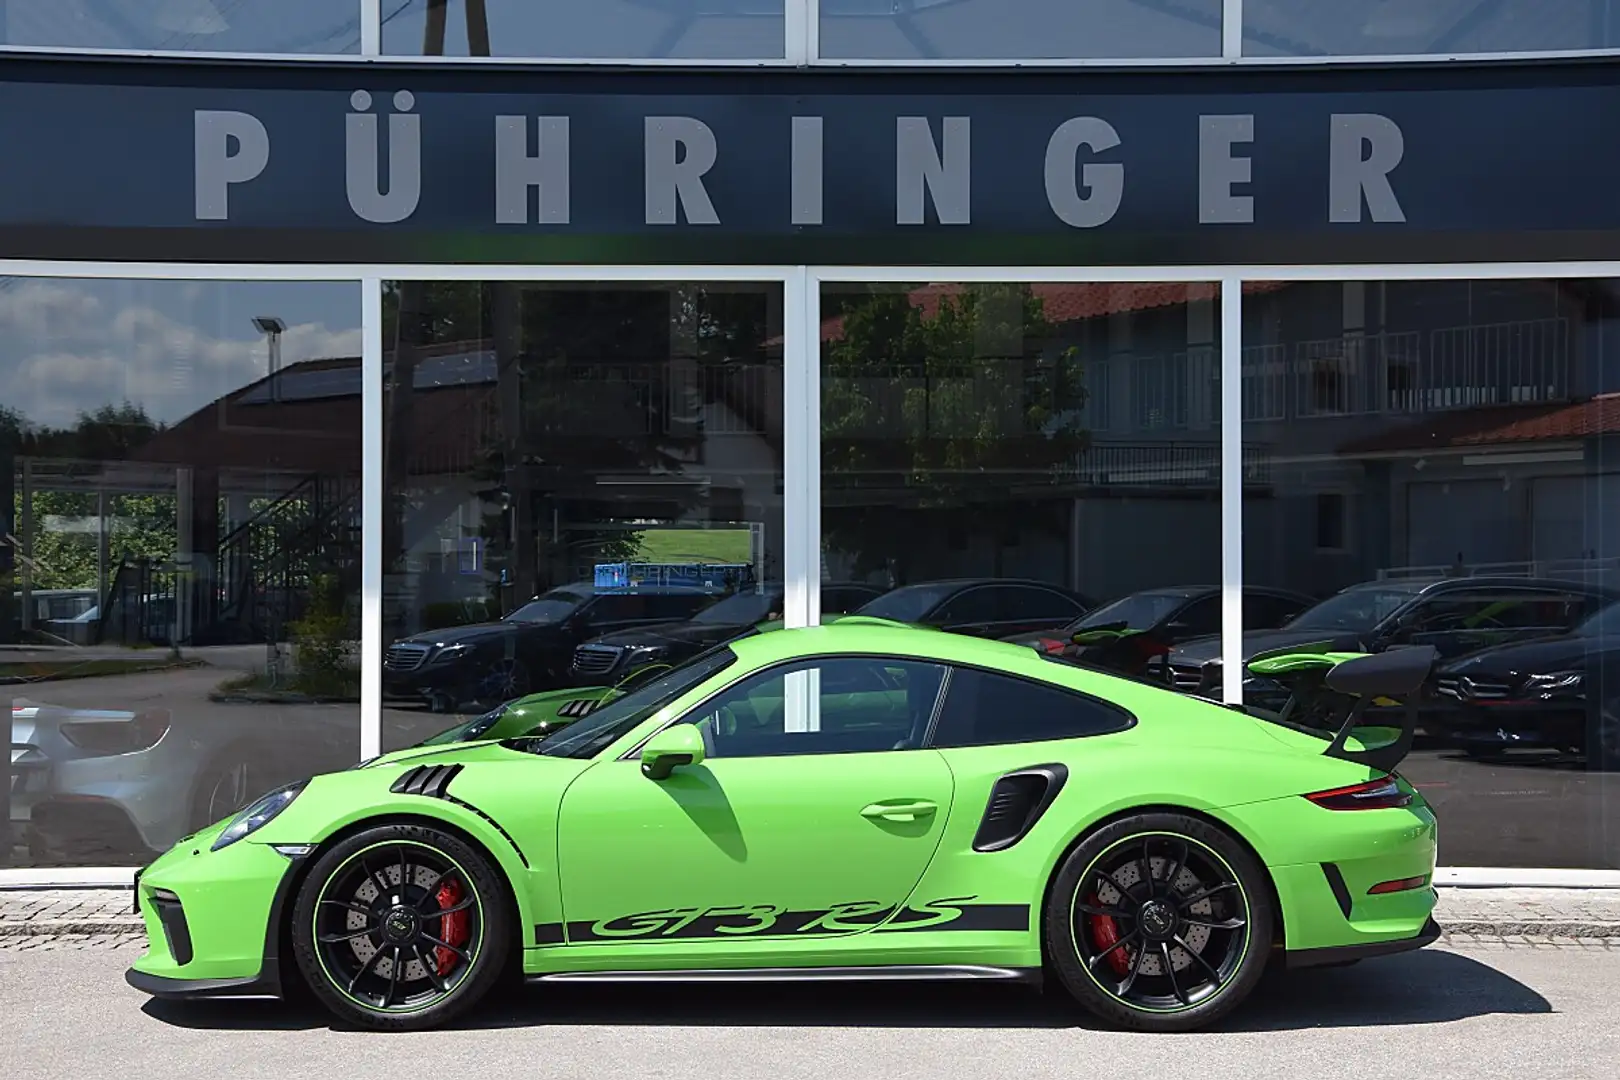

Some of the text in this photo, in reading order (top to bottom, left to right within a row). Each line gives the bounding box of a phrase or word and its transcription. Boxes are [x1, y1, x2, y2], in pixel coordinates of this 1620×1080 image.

[194, 90, 1407, 228] PÜHRINGER
[591, 895, 979, 937] GT3 RS
